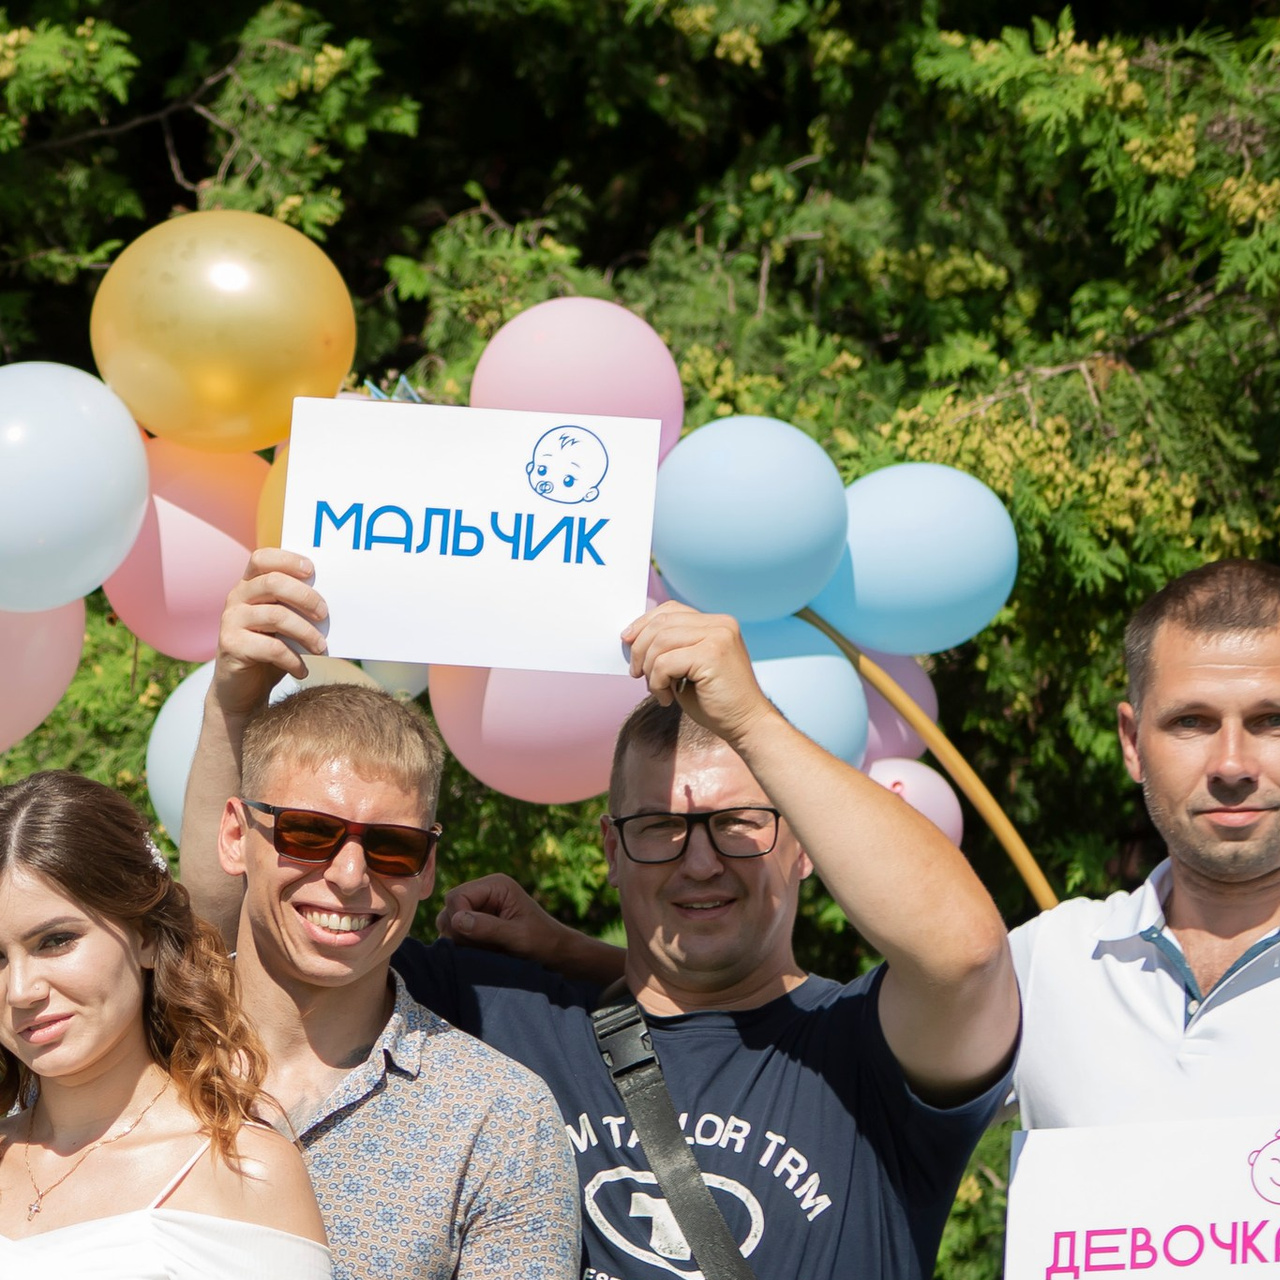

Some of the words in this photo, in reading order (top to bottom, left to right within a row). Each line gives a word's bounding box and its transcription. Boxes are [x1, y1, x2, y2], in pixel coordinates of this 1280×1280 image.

[313, 500, 609, 566] МАЛЬЧИК
[758, 1130, 833, 1222] TRM
[1045, 1220, 1280, 1280] ДЕВОЧК
